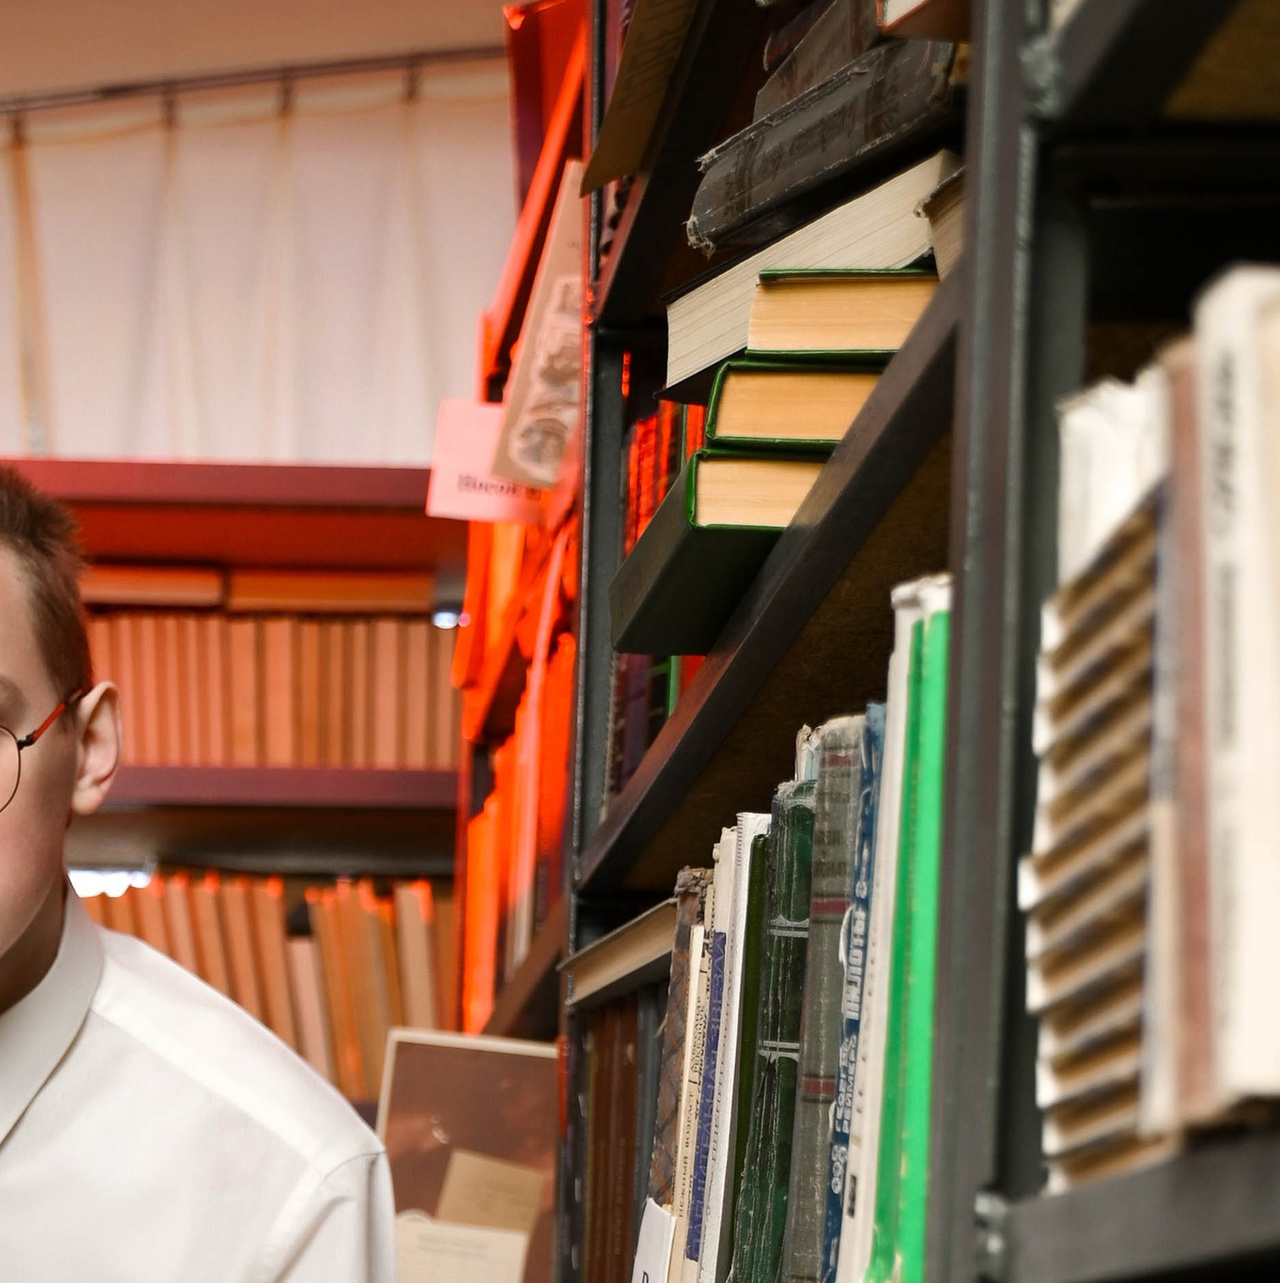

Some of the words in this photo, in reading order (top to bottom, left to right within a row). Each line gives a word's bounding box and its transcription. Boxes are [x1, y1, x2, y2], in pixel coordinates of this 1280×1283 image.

[840, 906, 868, 1020] ПИЛОТЫ
[678, 1155, 689, 1218] НЕЖНЫЙ
[684, 1091, 695, 1148] ВОЗРАСТ
